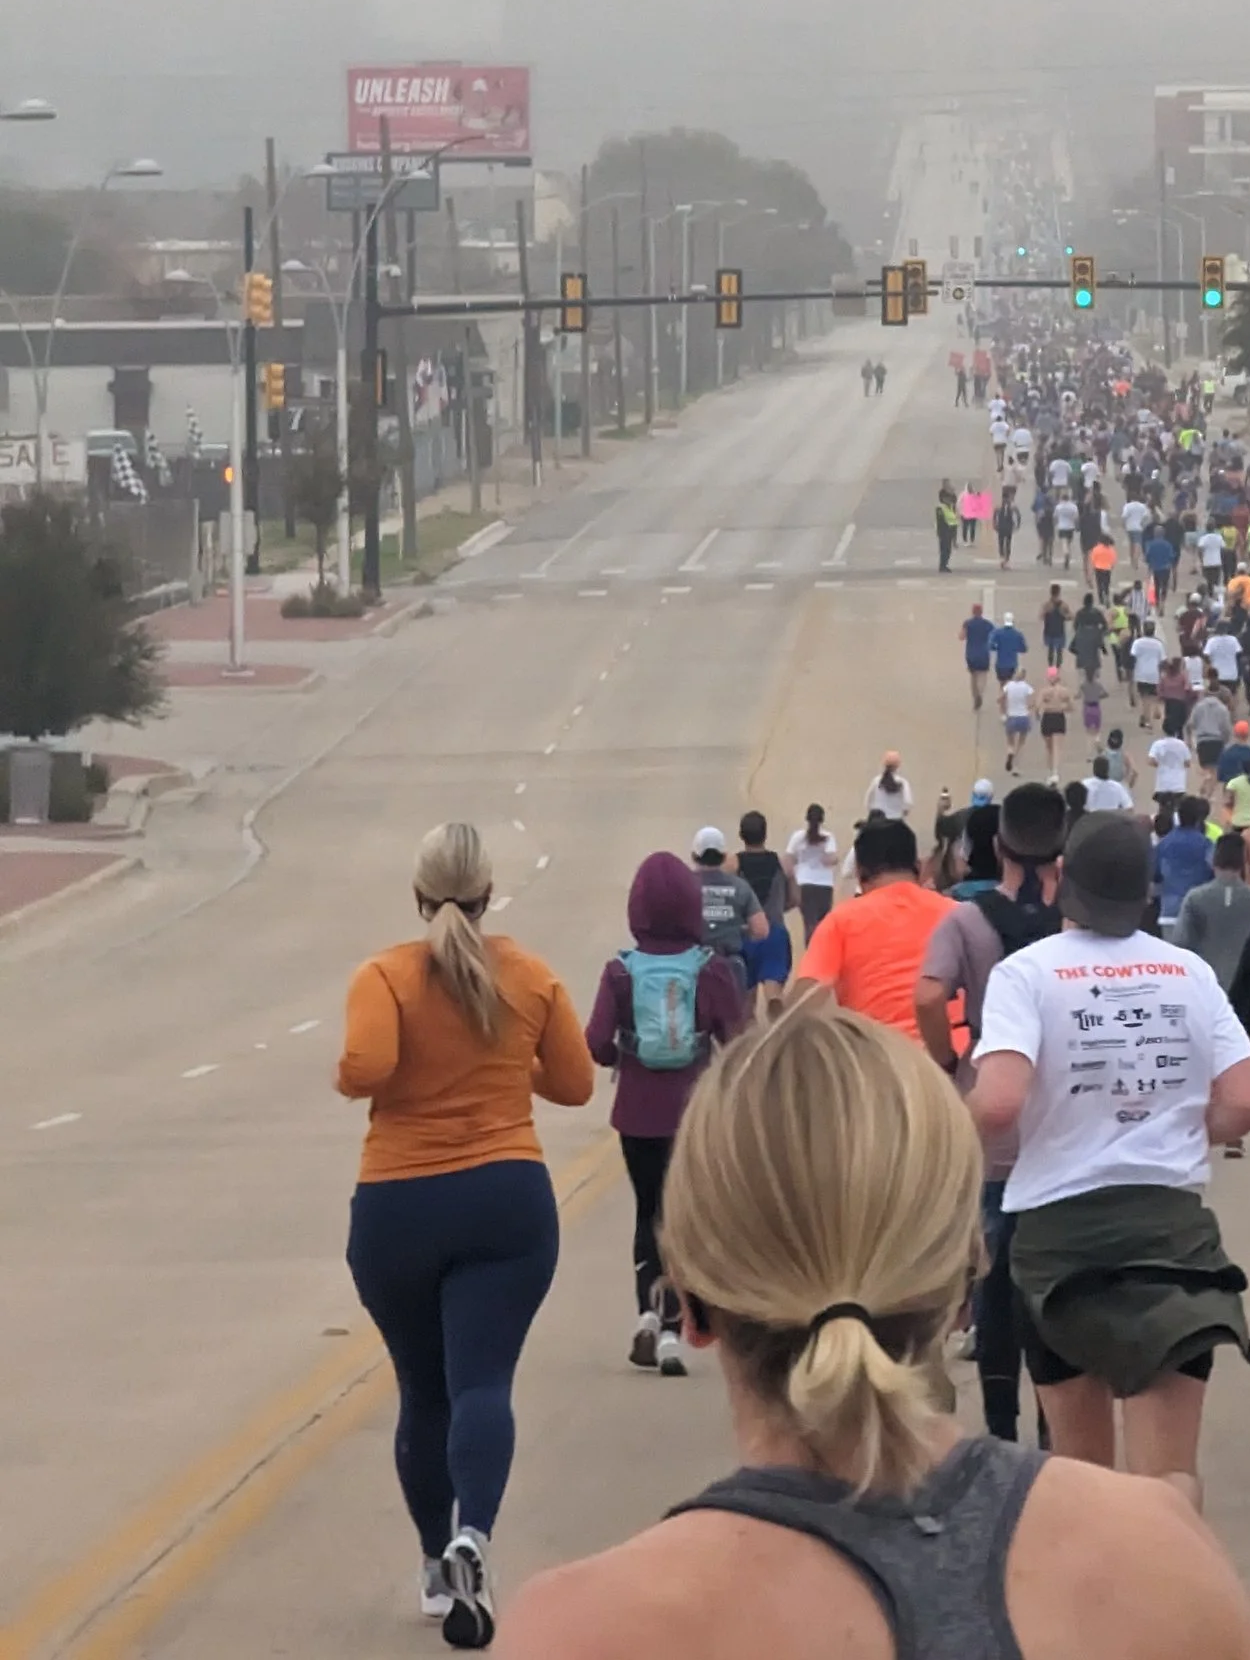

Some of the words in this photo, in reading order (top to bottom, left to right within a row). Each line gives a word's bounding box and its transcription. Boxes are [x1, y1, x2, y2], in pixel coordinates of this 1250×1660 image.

[354, 77, 450, 104] UNLEASH
[0, 442, 70, 467] SAE
[1054, 966, 1089, 980] THE
[1093, 963, 1187, 978] COWTOWN
